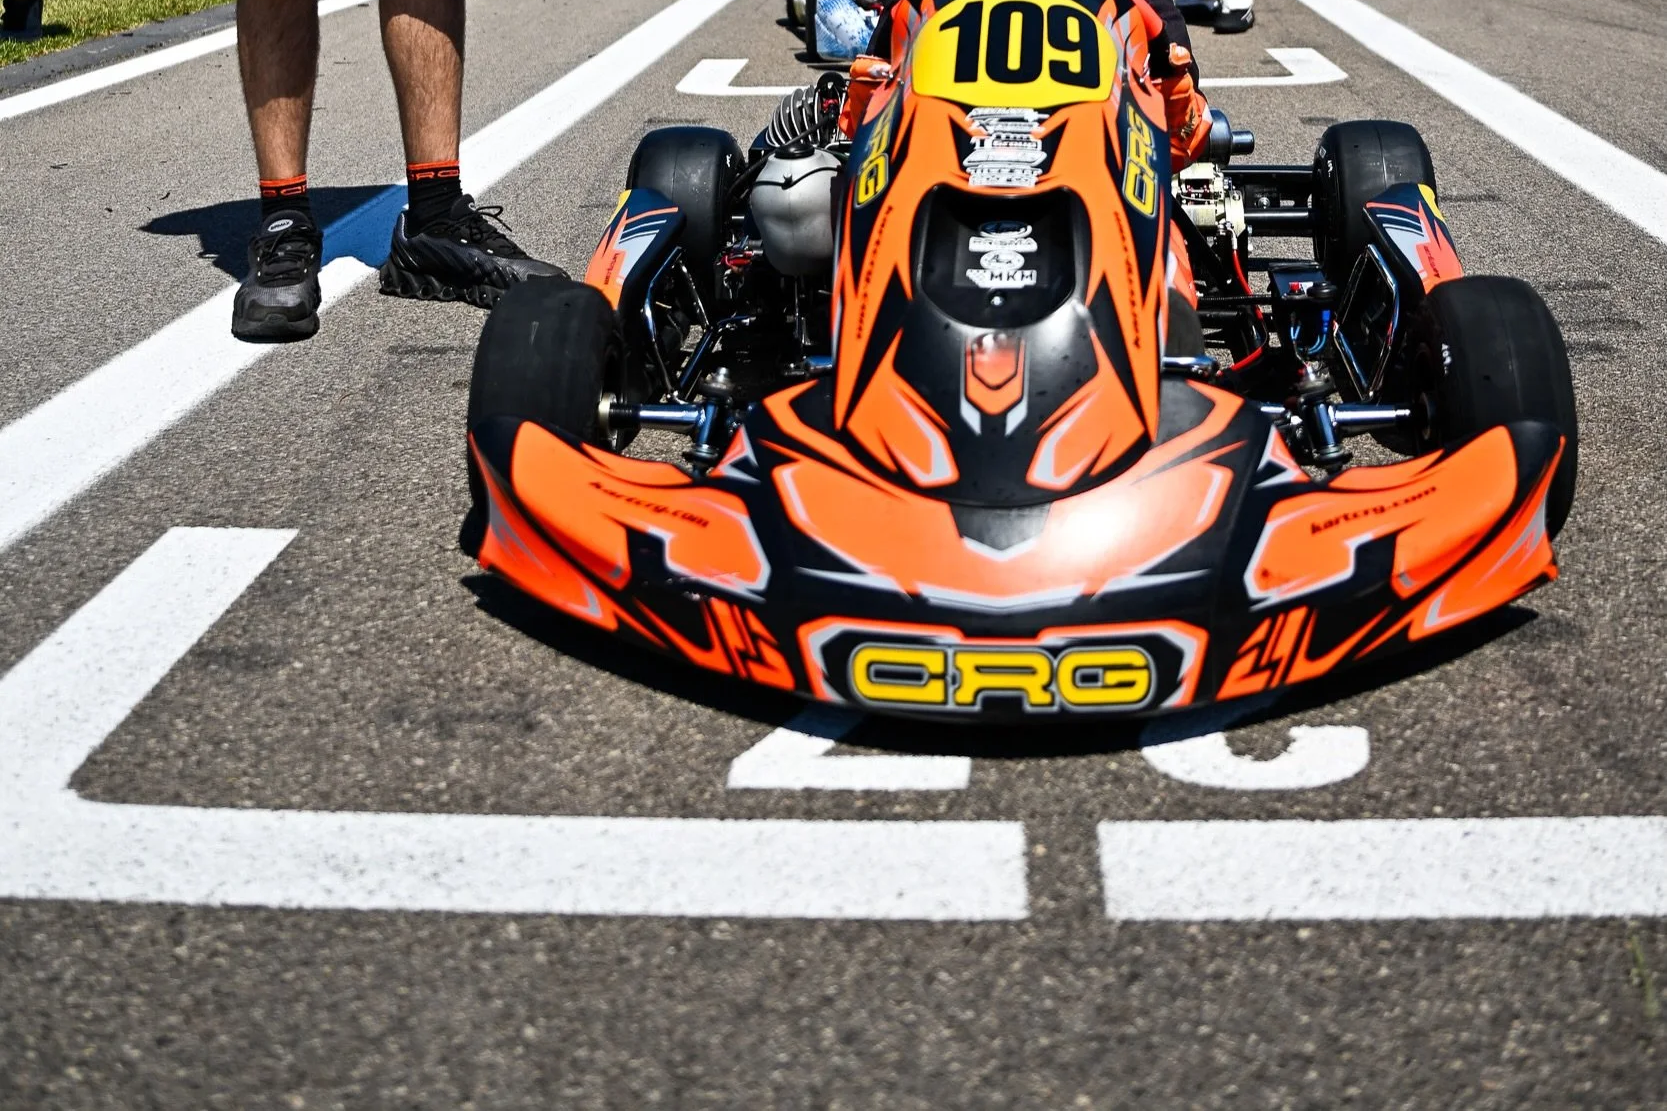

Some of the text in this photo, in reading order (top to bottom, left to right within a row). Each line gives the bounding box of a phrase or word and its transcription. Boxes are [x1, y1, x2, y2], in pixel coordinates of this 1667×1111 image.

[938, 0, 1101, 89] 109
[1122, 102, 1157, 219] CRG
[990, 270, 1033, 281] MKM
[588, 481, 710, 529] kartcrg.com
[1310, 486, 1437, 535] kartcrg.com
[850, 644, 1154, 708] CRG
